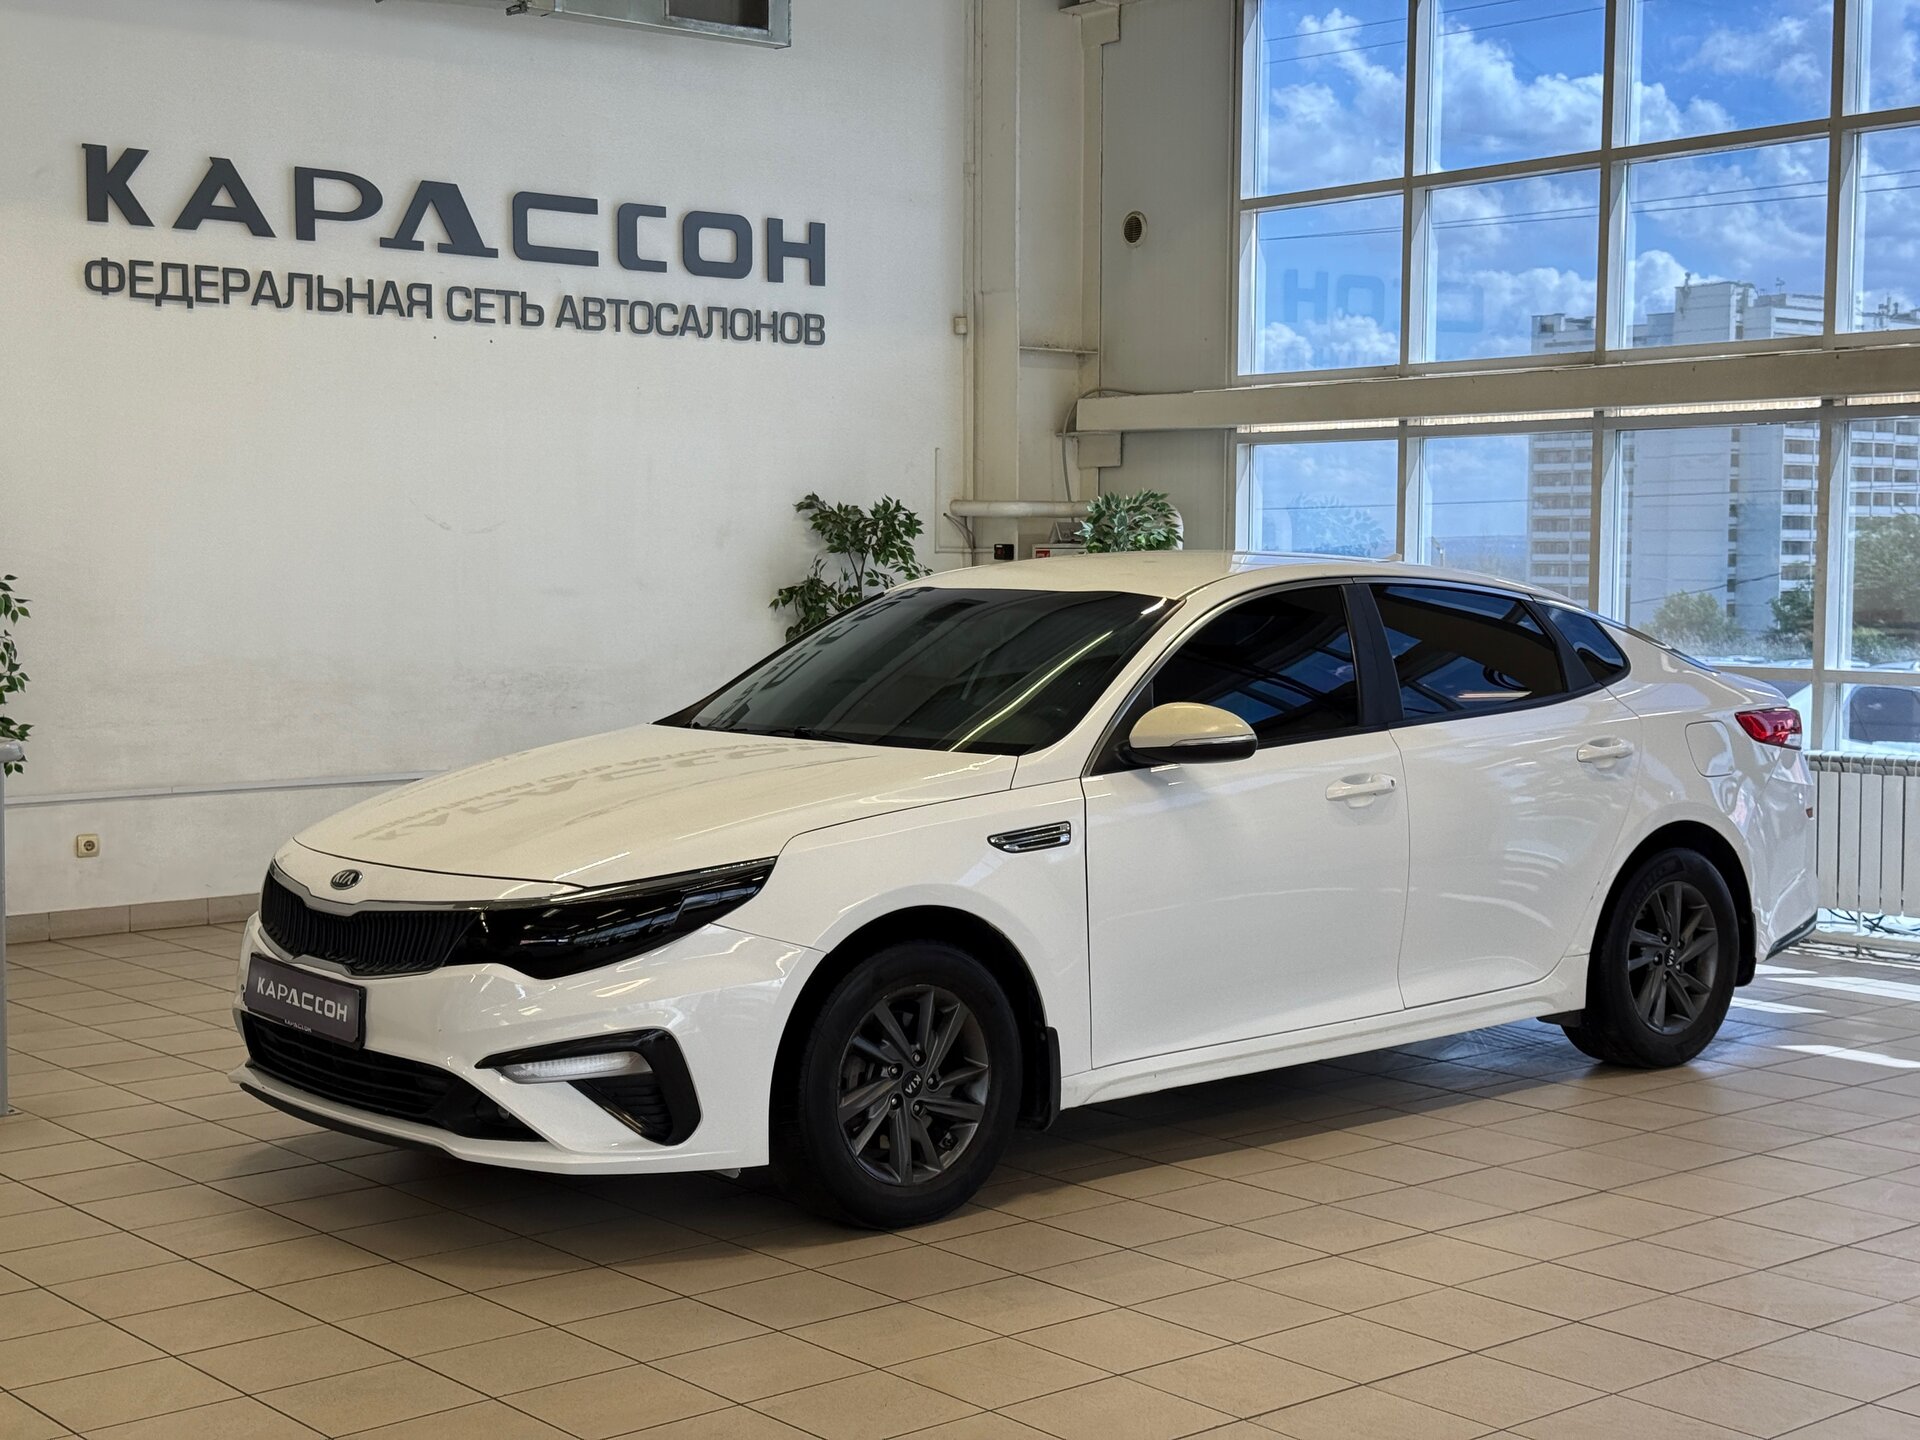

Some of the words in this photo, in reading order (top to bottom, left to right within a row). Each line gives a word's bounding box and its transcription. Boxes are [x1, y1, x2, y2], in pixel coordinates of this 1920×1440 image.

[84, 257, 433, 319] ФЕДЕРАЛЬНАЯ
[446, 286, 545, 327] СЕТЬ
[555, 295, 826, 346] АВТОСАЛОНОВ
[332, 871, 356, 885] KIA
[905, 1074, 921, 1094] KIA
